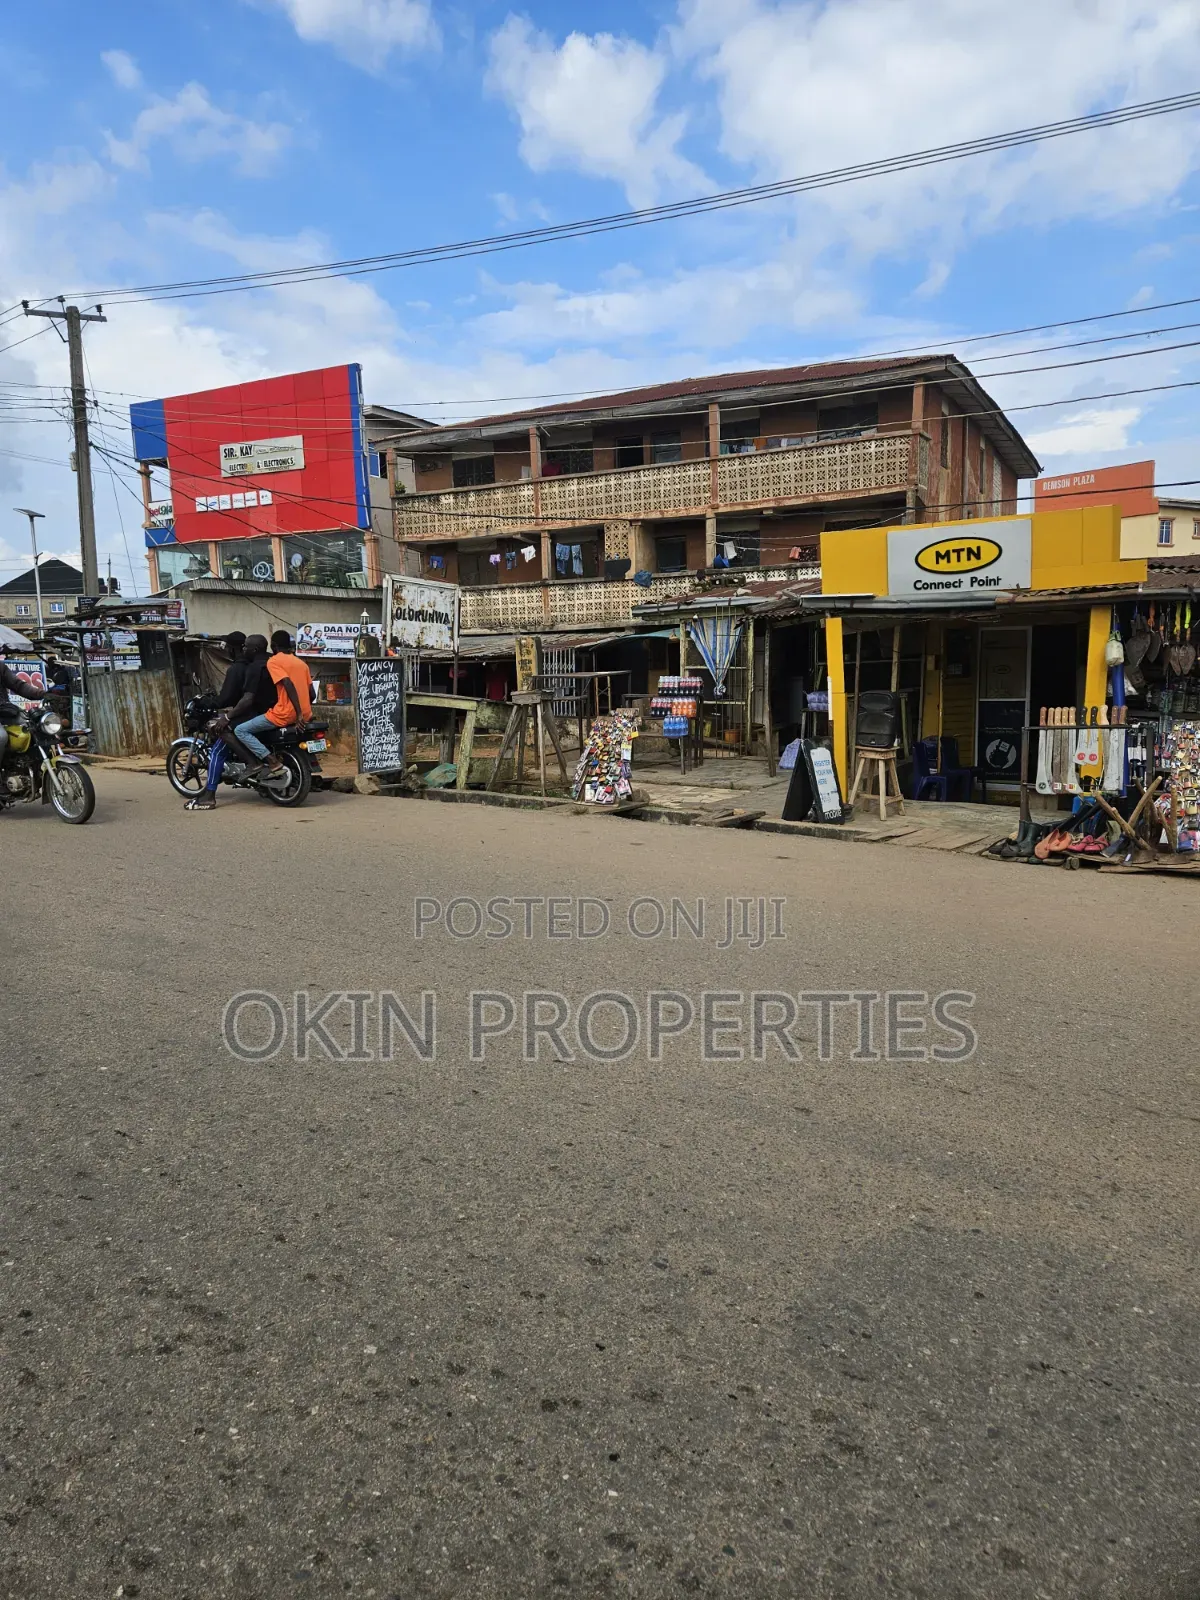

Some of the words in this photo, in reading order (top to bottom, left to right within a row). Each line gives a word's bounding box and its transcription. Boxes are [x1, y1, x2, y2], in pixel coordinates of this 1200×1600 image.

[240, 444, 253, 457] KAY
[1073, 474, 1095, 486] PLAZA
[935, 545, 981, 565] MTN
[913, 579, 963, 590] Connect
[970, 576, 1002, 587] Point
